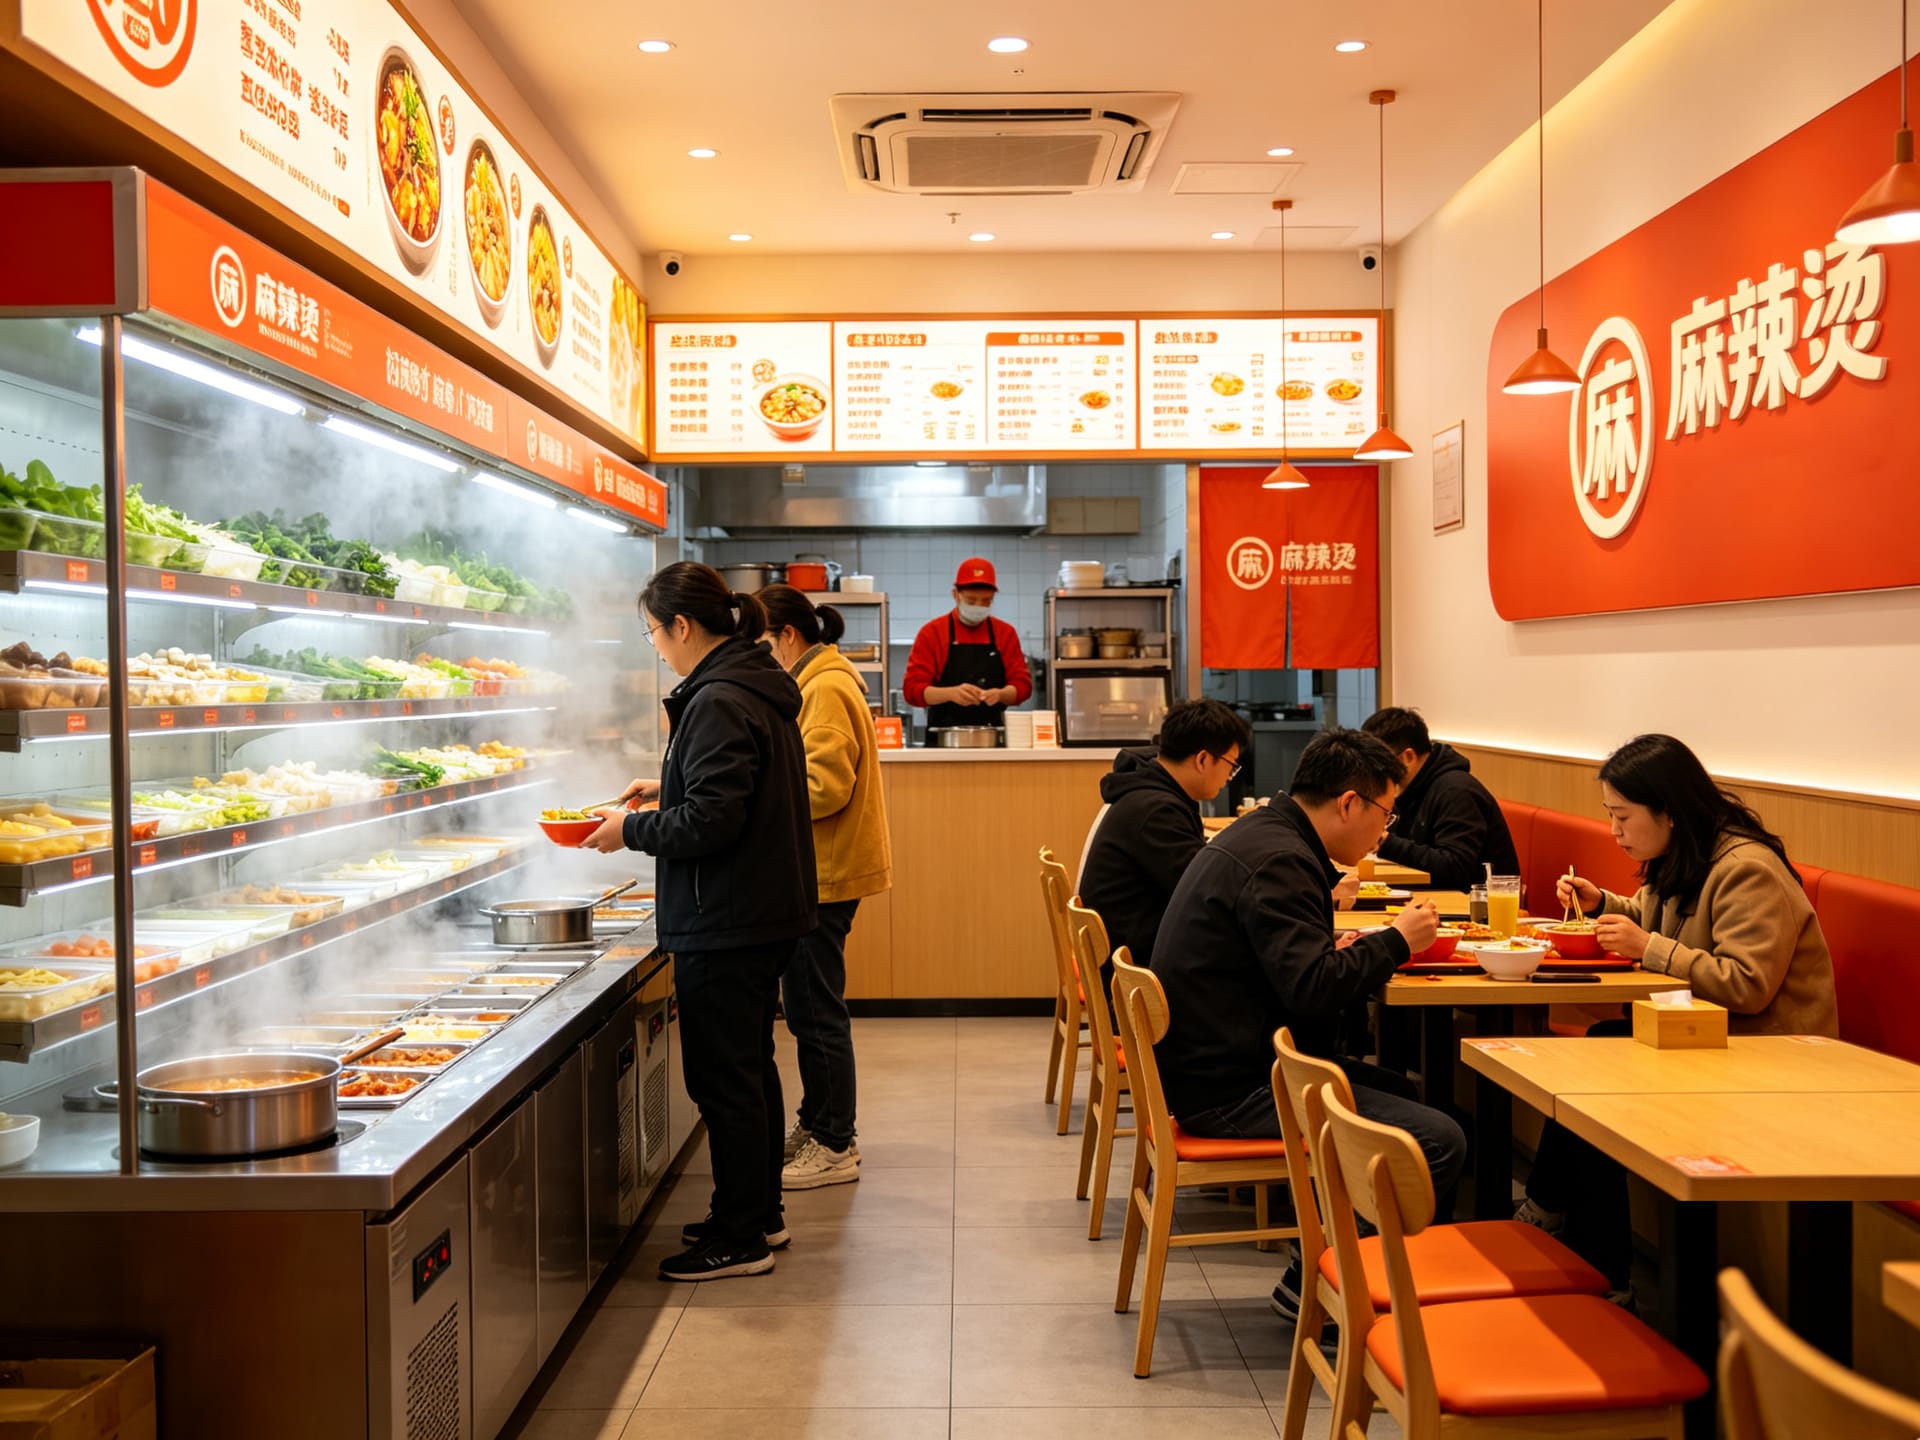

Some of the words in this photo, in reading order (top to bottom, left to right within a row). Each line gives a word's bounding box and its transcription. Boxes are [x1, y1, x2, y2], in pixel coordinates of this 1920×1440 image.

[219, 262, 240, 313] 麻
[255, 272, 320, 344] 麻辣烫
[1665, 240, 1889, 442] 麻辣烫
[1583, 356, 1639, 500] 麻
[1237, 548, 1266, 579] 麻
[1280, 541, 1357, 572] 麻辣烫
